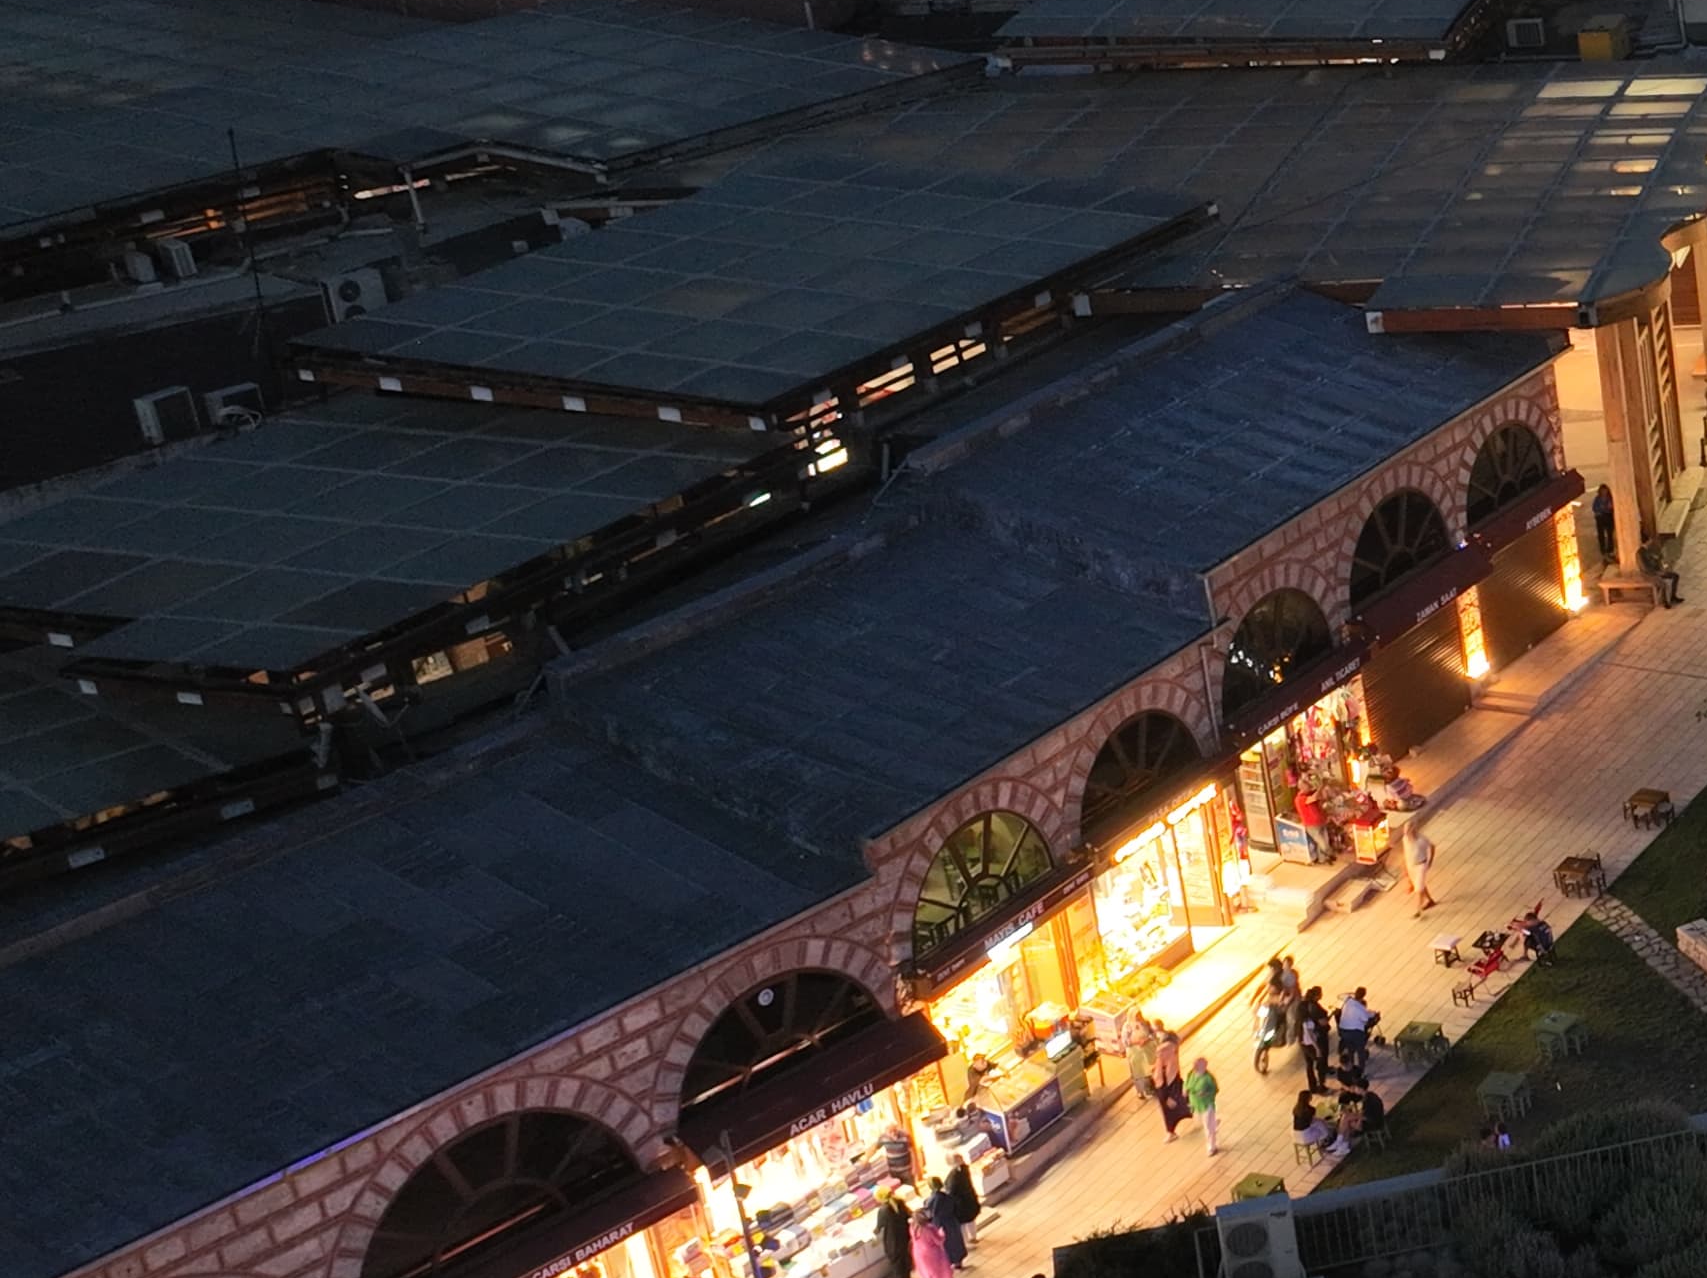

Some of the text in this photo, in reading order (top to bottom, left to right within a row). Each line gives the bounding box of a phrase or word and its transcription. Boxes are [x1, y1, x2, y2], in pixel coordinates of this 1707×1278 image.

[790, 1083, 875, 1136] ACAR HAVLU
[575, 1222, 635, 1262] BAHARAT
